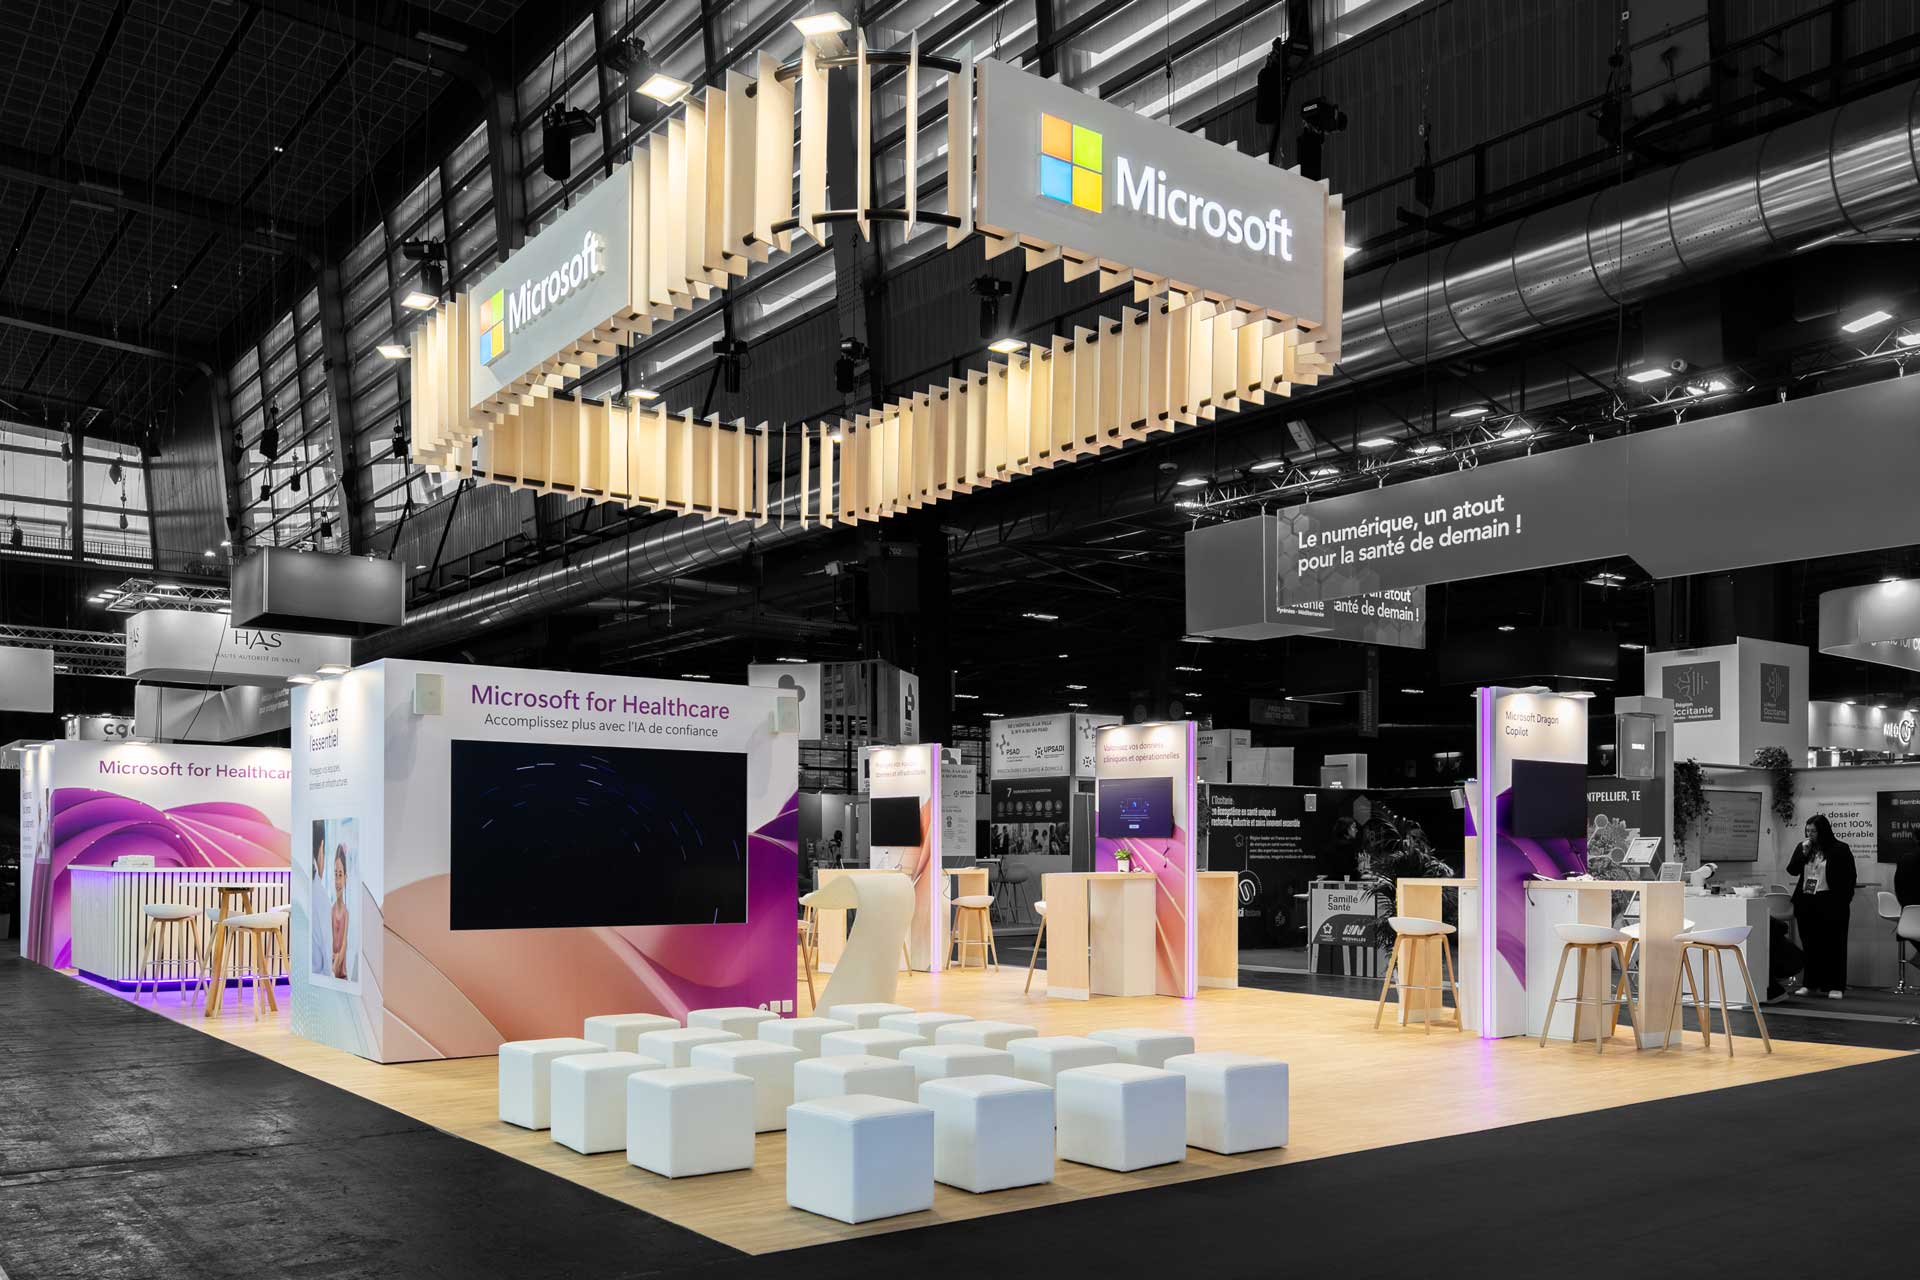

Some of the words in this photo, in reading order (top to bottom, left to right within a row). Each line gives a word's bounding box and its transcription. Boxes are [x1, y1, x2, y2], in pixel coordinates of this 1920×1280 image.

[1117, 155, 1293, 262] Microsoft
[509, 230, 599, 334] Microsoft
[1299, 531, 1317, 549] Le
[1321, 516, 1418, 544] numérique,
[1424, 508, 1447, 525] un
[1452, 494, 1504, 520] atout
[1298, 553, 1336, 576] pour
[1341, 546, 1354, 564] la
[1359, 536, 1405, 560] santé
[1410, 531, 1434, 552] de
[1439, 518, 1510, 547] demain
[1516, 514, 1521, 534] !
[1384, 589, 1412, 602] atout
[1361, 600, 1375, 616] de
[1377, 602, 1414, 621] demain
[234, 630, 282, 650] HAS
[471, 684, 580, 710] Microsoft
[586, 691, 616, 712] for
[623, 694, 730, 719] Healthcare
[484, 713, 569, 730] Accomplissez
[572, 718, 596, 732] plus
[599, 722, 625, 732] avec
[628, 721, 646, 733] l'IA
[648, 722, 662, 734] de
[665, 724, 718, 737] confiance
[1505, 711, 1536, 723] Microsoft
[1537, 714, 1559, 727] Dragon
[1505, 725, 1528, 738] Copilot
[1104, 755, 1128, 764] cliniques
[1136, 751, 1180, 762] opérationnelles
[99, 760, 183, 776] Microsoft
[187, 763, 212, 776] for
[1587, 791, 1629, 802] NTPELLIER,
[1631, 791, 1640, 801] TE
[1849, 820, 1873, 828] 100%
[1891, 821, 1901, 829] Et
[1328, 894, 1359, 904] Famille
